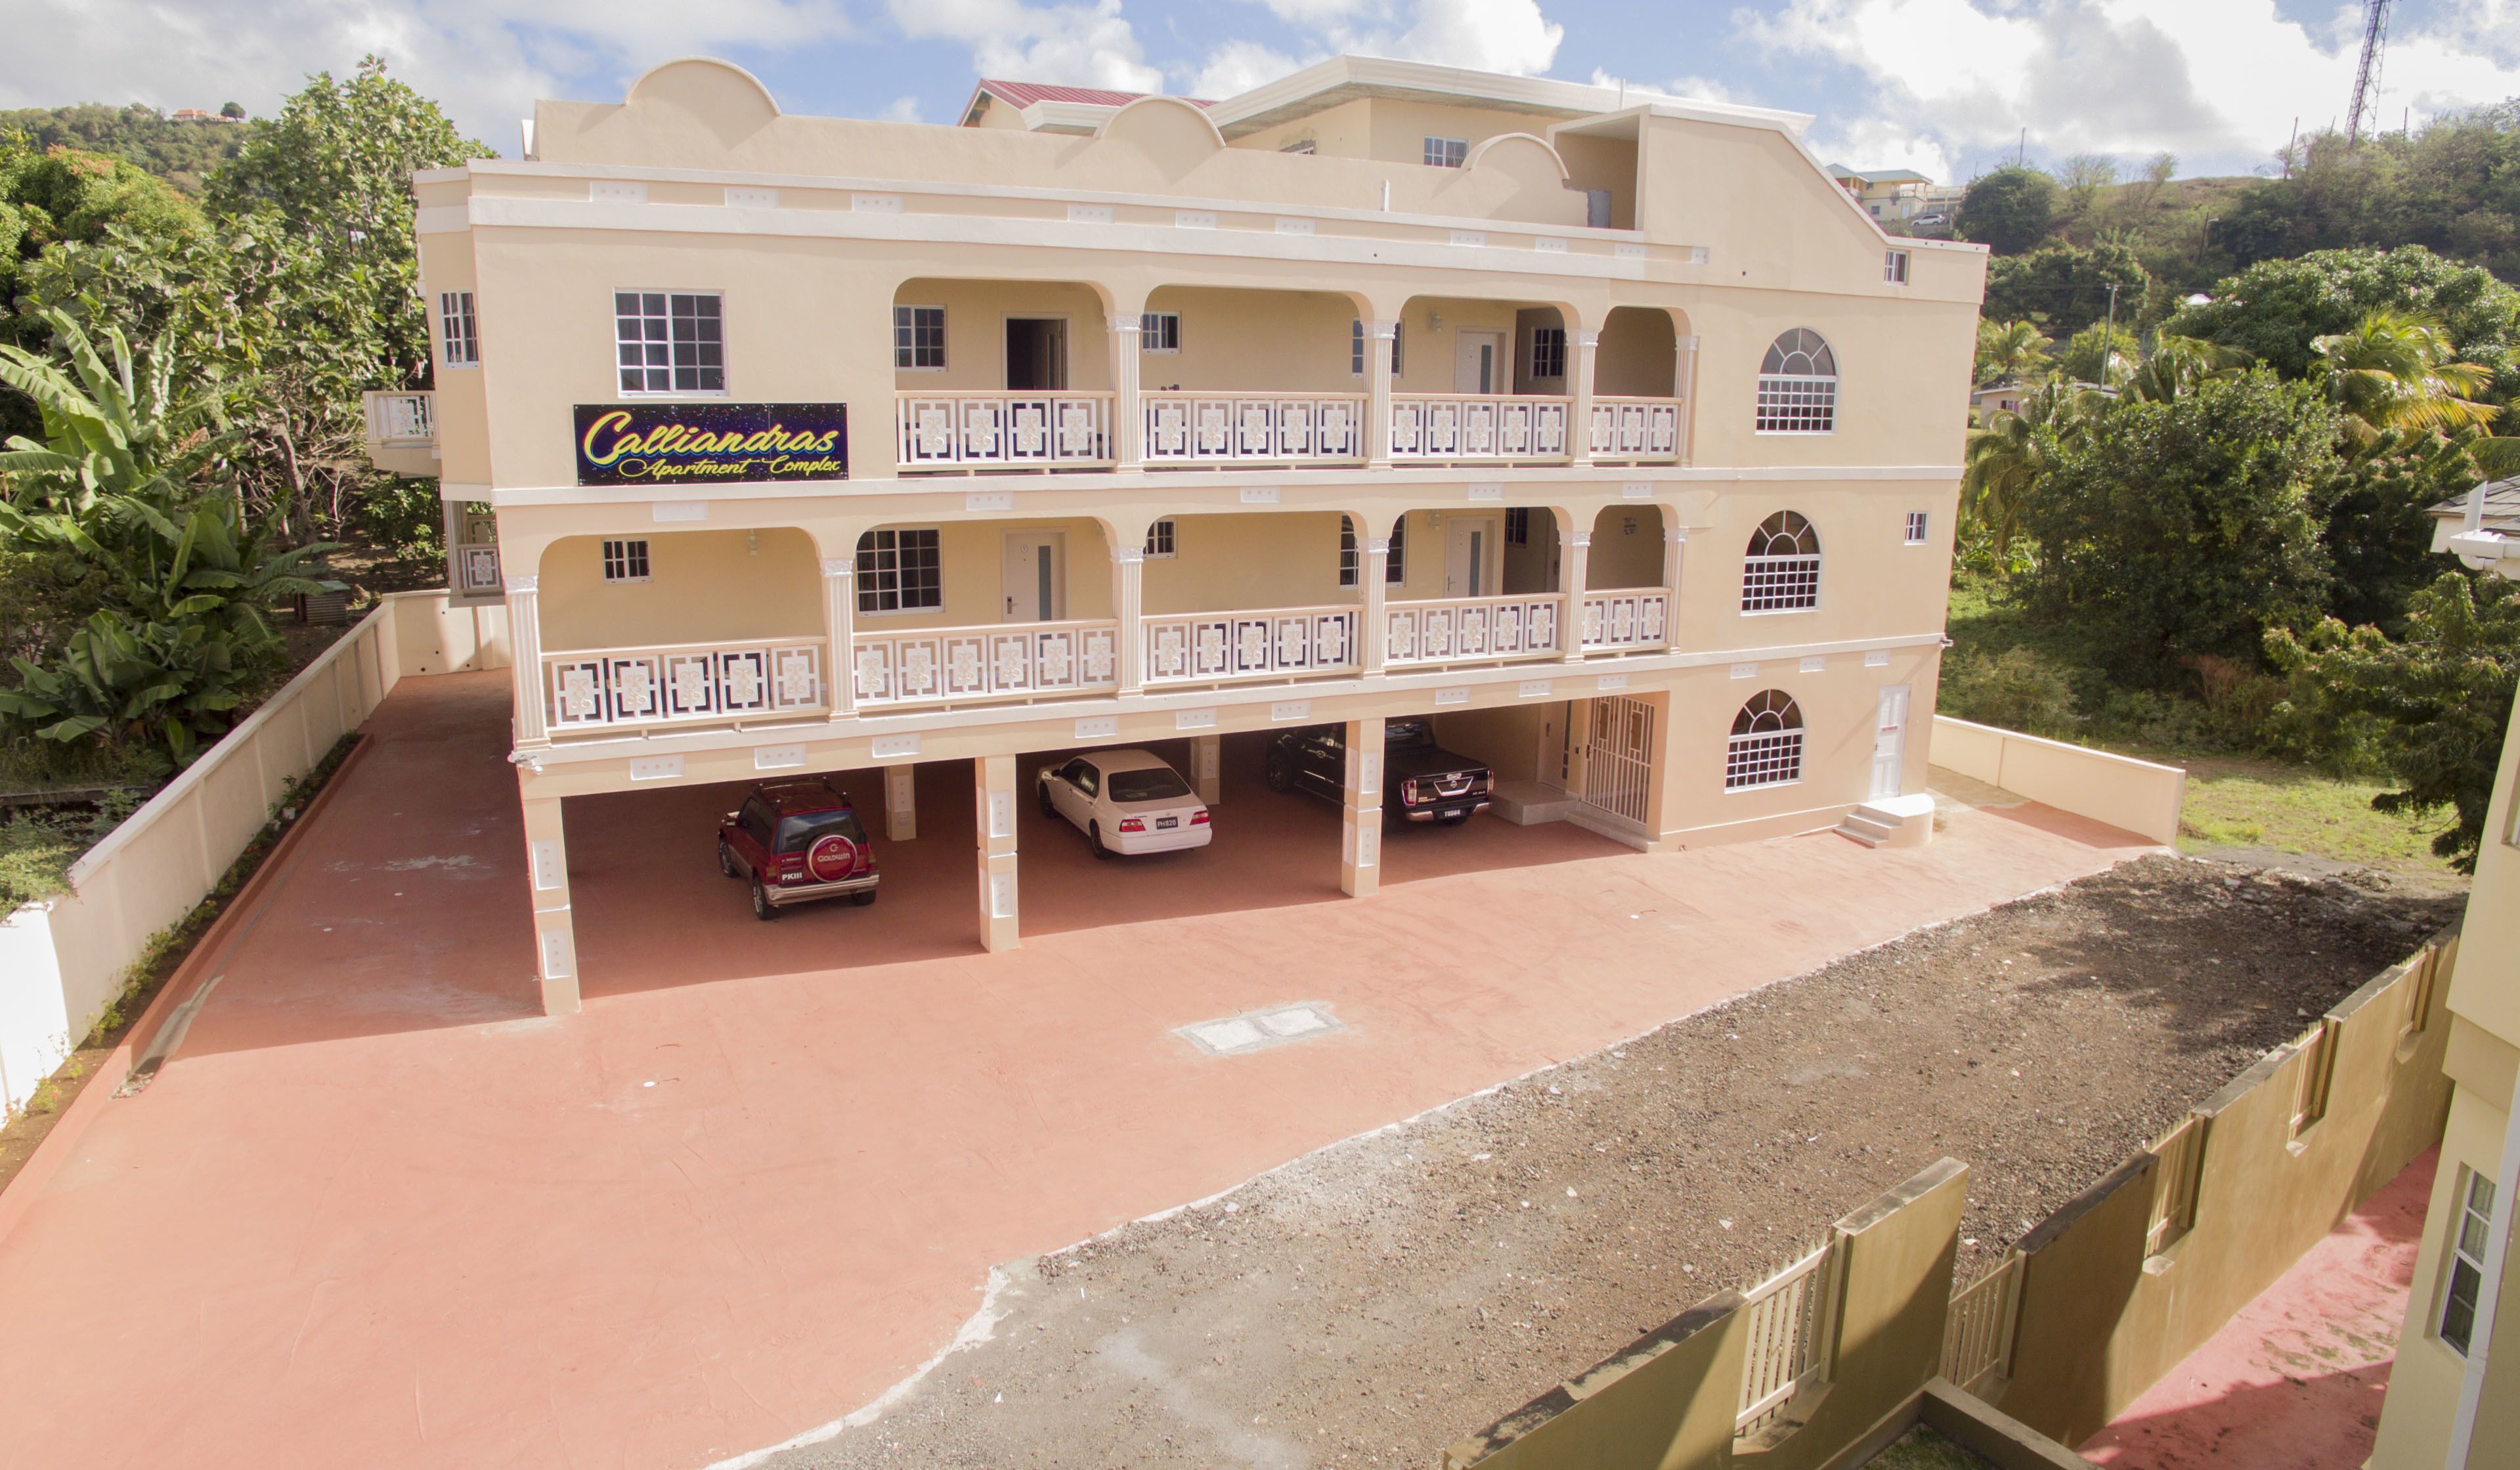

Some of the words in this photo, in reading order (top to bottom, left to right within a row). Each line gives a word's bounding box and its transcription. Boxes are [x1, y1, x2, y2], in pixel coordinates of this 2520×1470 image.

[584, 410, 839, 465] Calliandras
[619, 458, 761, 480] Apartment
[762, 455, 840, 476] Complex
